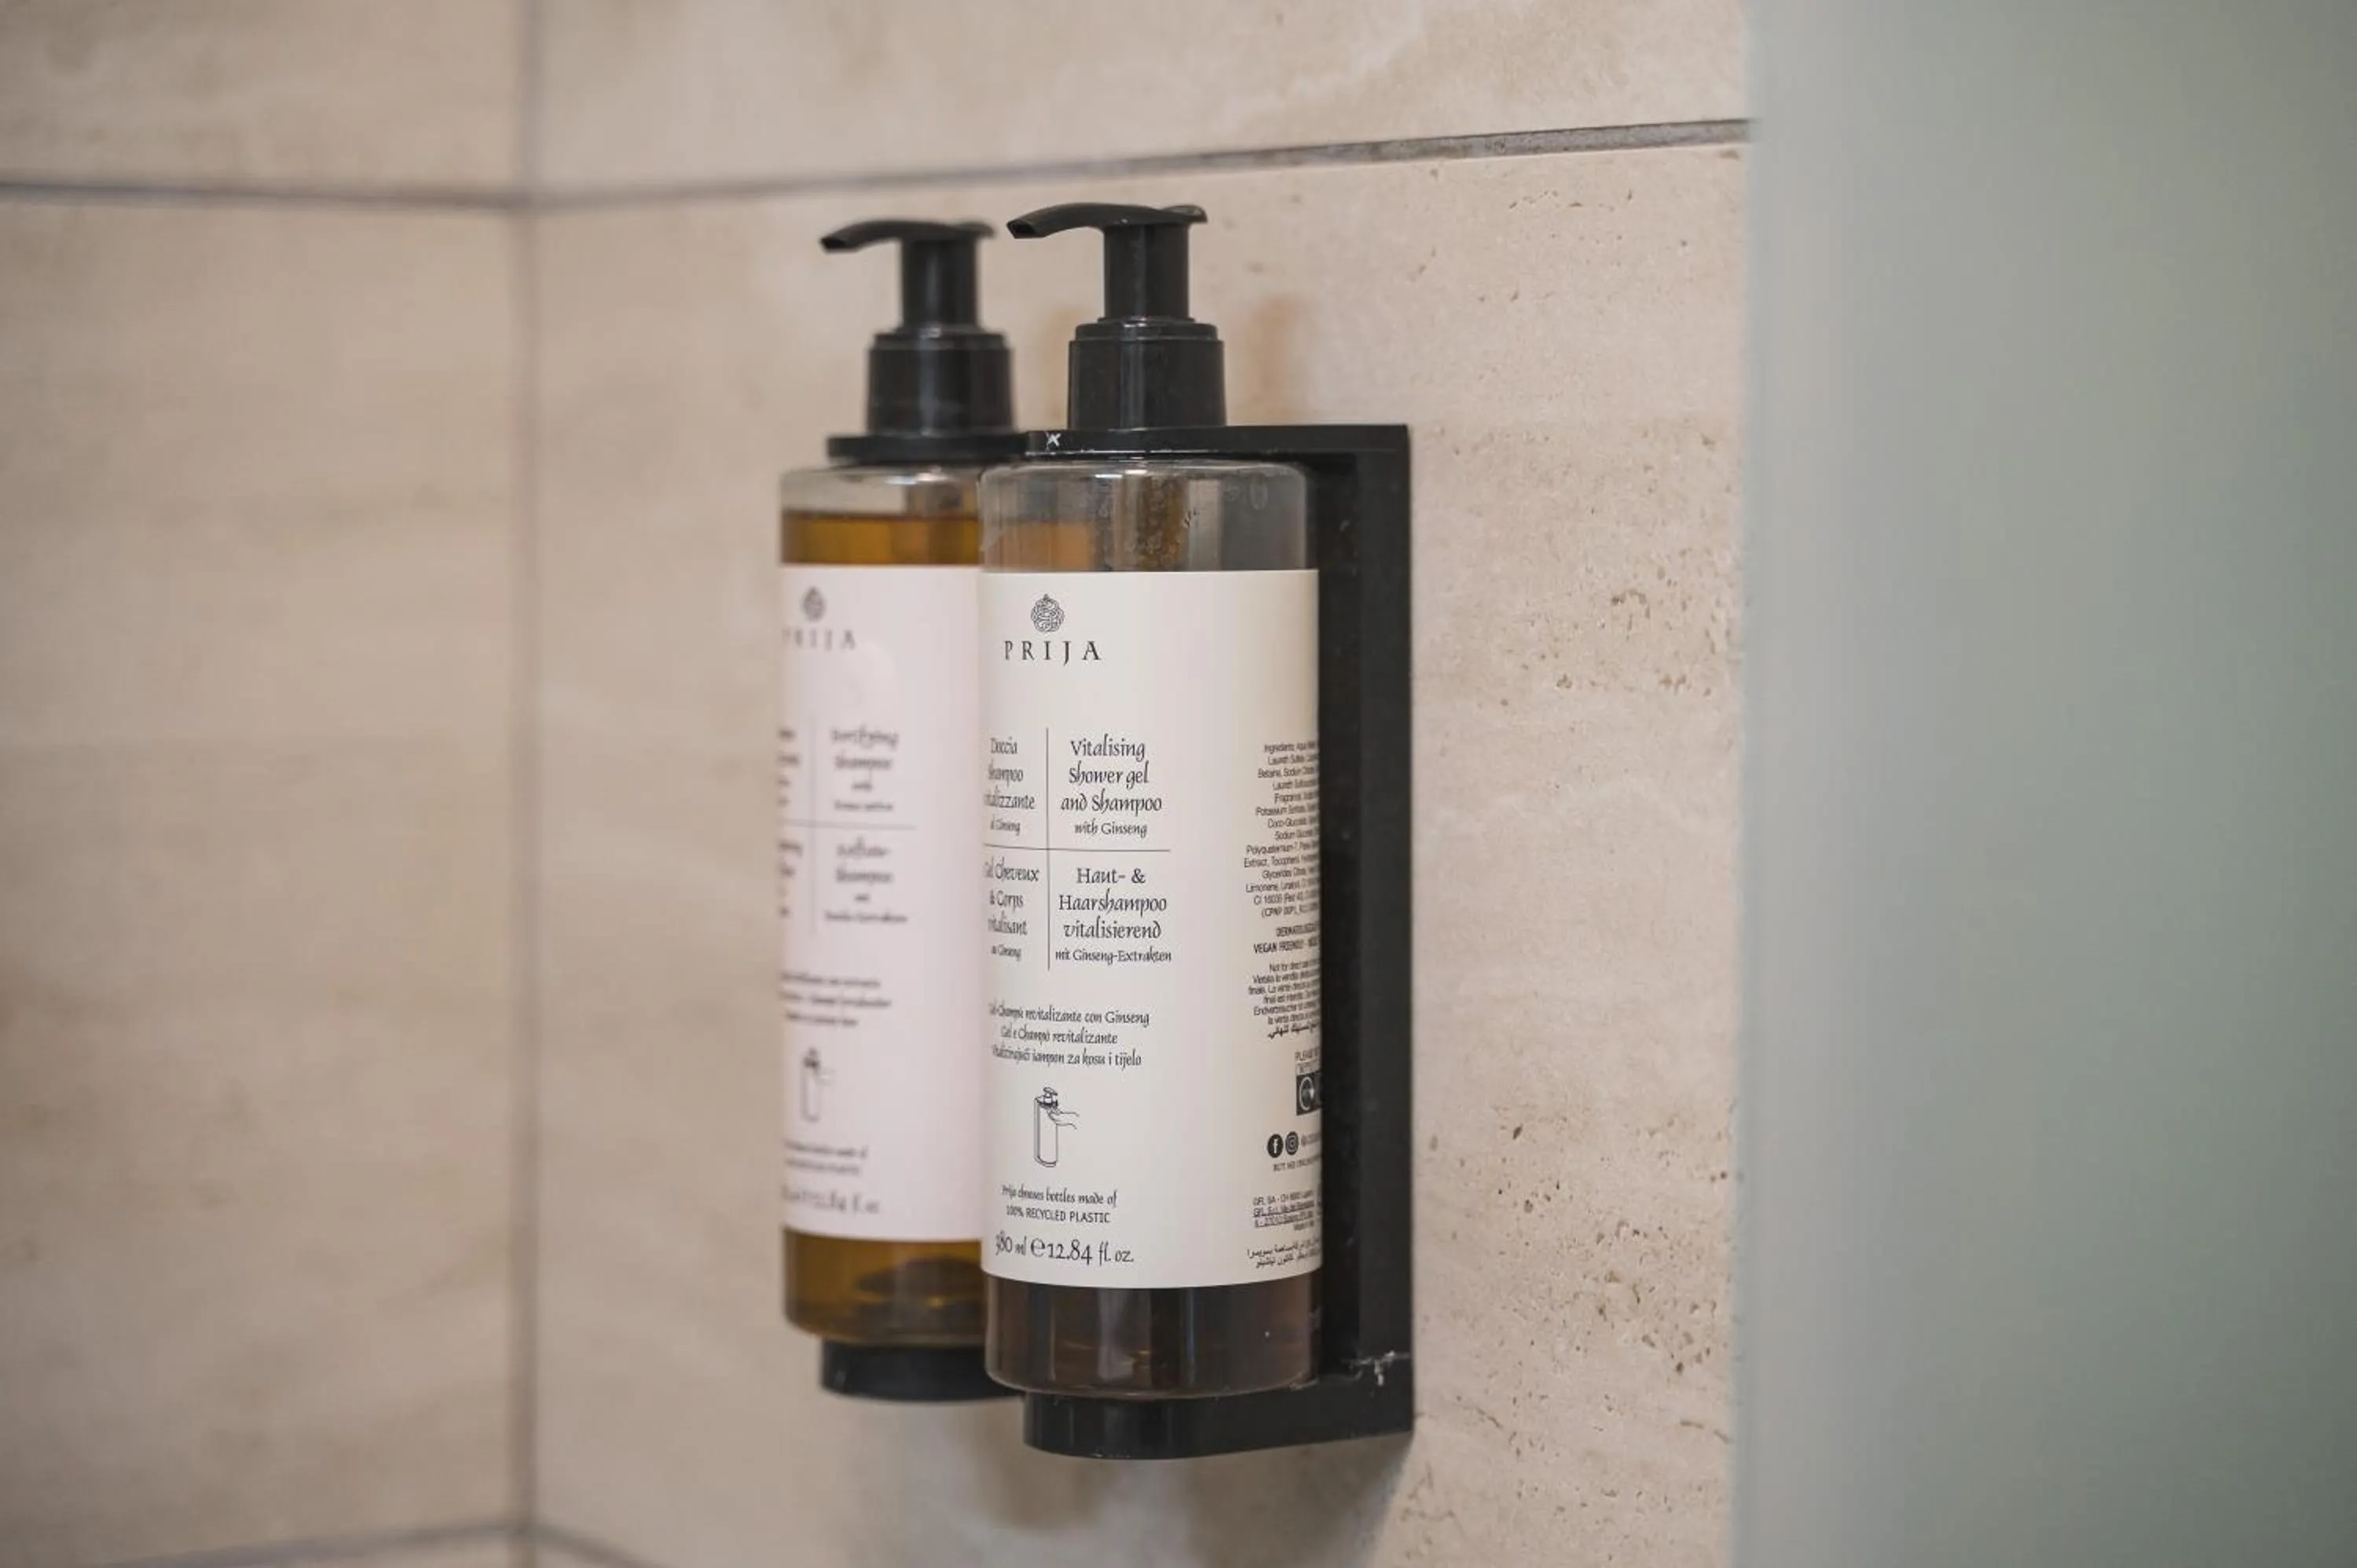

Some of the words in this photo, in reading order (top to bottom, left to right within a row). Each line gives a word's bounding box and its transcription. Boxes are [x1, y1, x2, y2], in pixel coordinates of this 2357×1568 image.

[1004, 640, 1102, 666] PRIJA
[1070, 733, 1146, 762] Vitalising
[1069, 760, 1124, 787] Shower
[1126, 760, 1149, 790] gel
[1061, 793, 1088, 812] and
[1091, 787, 1163, 817] Shampoo
[1074, 818, 1098, 836] with
[1101, 821, 1148, 839] Ginseng
[1076, 866, 1127, 885] Haut-
[1131, 867, 1146, 885] &
[996, 889, 1025, 913] Corps
[1058, 888, 1168, 918] Haarshampoo
[1063, 915, 1162, 940] vitalisierend
[1055, 946, 1071, 962] mit
[1072, 945, 1172, 966] Ginseng-Extrakten
[1025, 1004, 1083, 1023] revitalizante
[1084, 1013, 1102, 1023] con
[1104, 1009, 1150, 1028] Ginseng
[1052, 1026, 1119, 1045] revitalizante
[1067, 1053, 1080, 1065] za
[1082, 1047, 1106, 1066] kosu
[1108, 1051, 1113, 1066] i
[1114, 1047, 1142, 1072] tijelo
[1046, 1186, 1076, 1204] bottles
[1078, 1191, 1105, 1205] made
[1106, 1189, 1119, 1208] of
[1025, 1207, 1067, 1222] RECYCLED
[1069, 1211, 1112, 1224] PLASTIC
[1098, 1241, 1112, 1267] fl.
[1114, 1250, 1135, 1263] oz.
